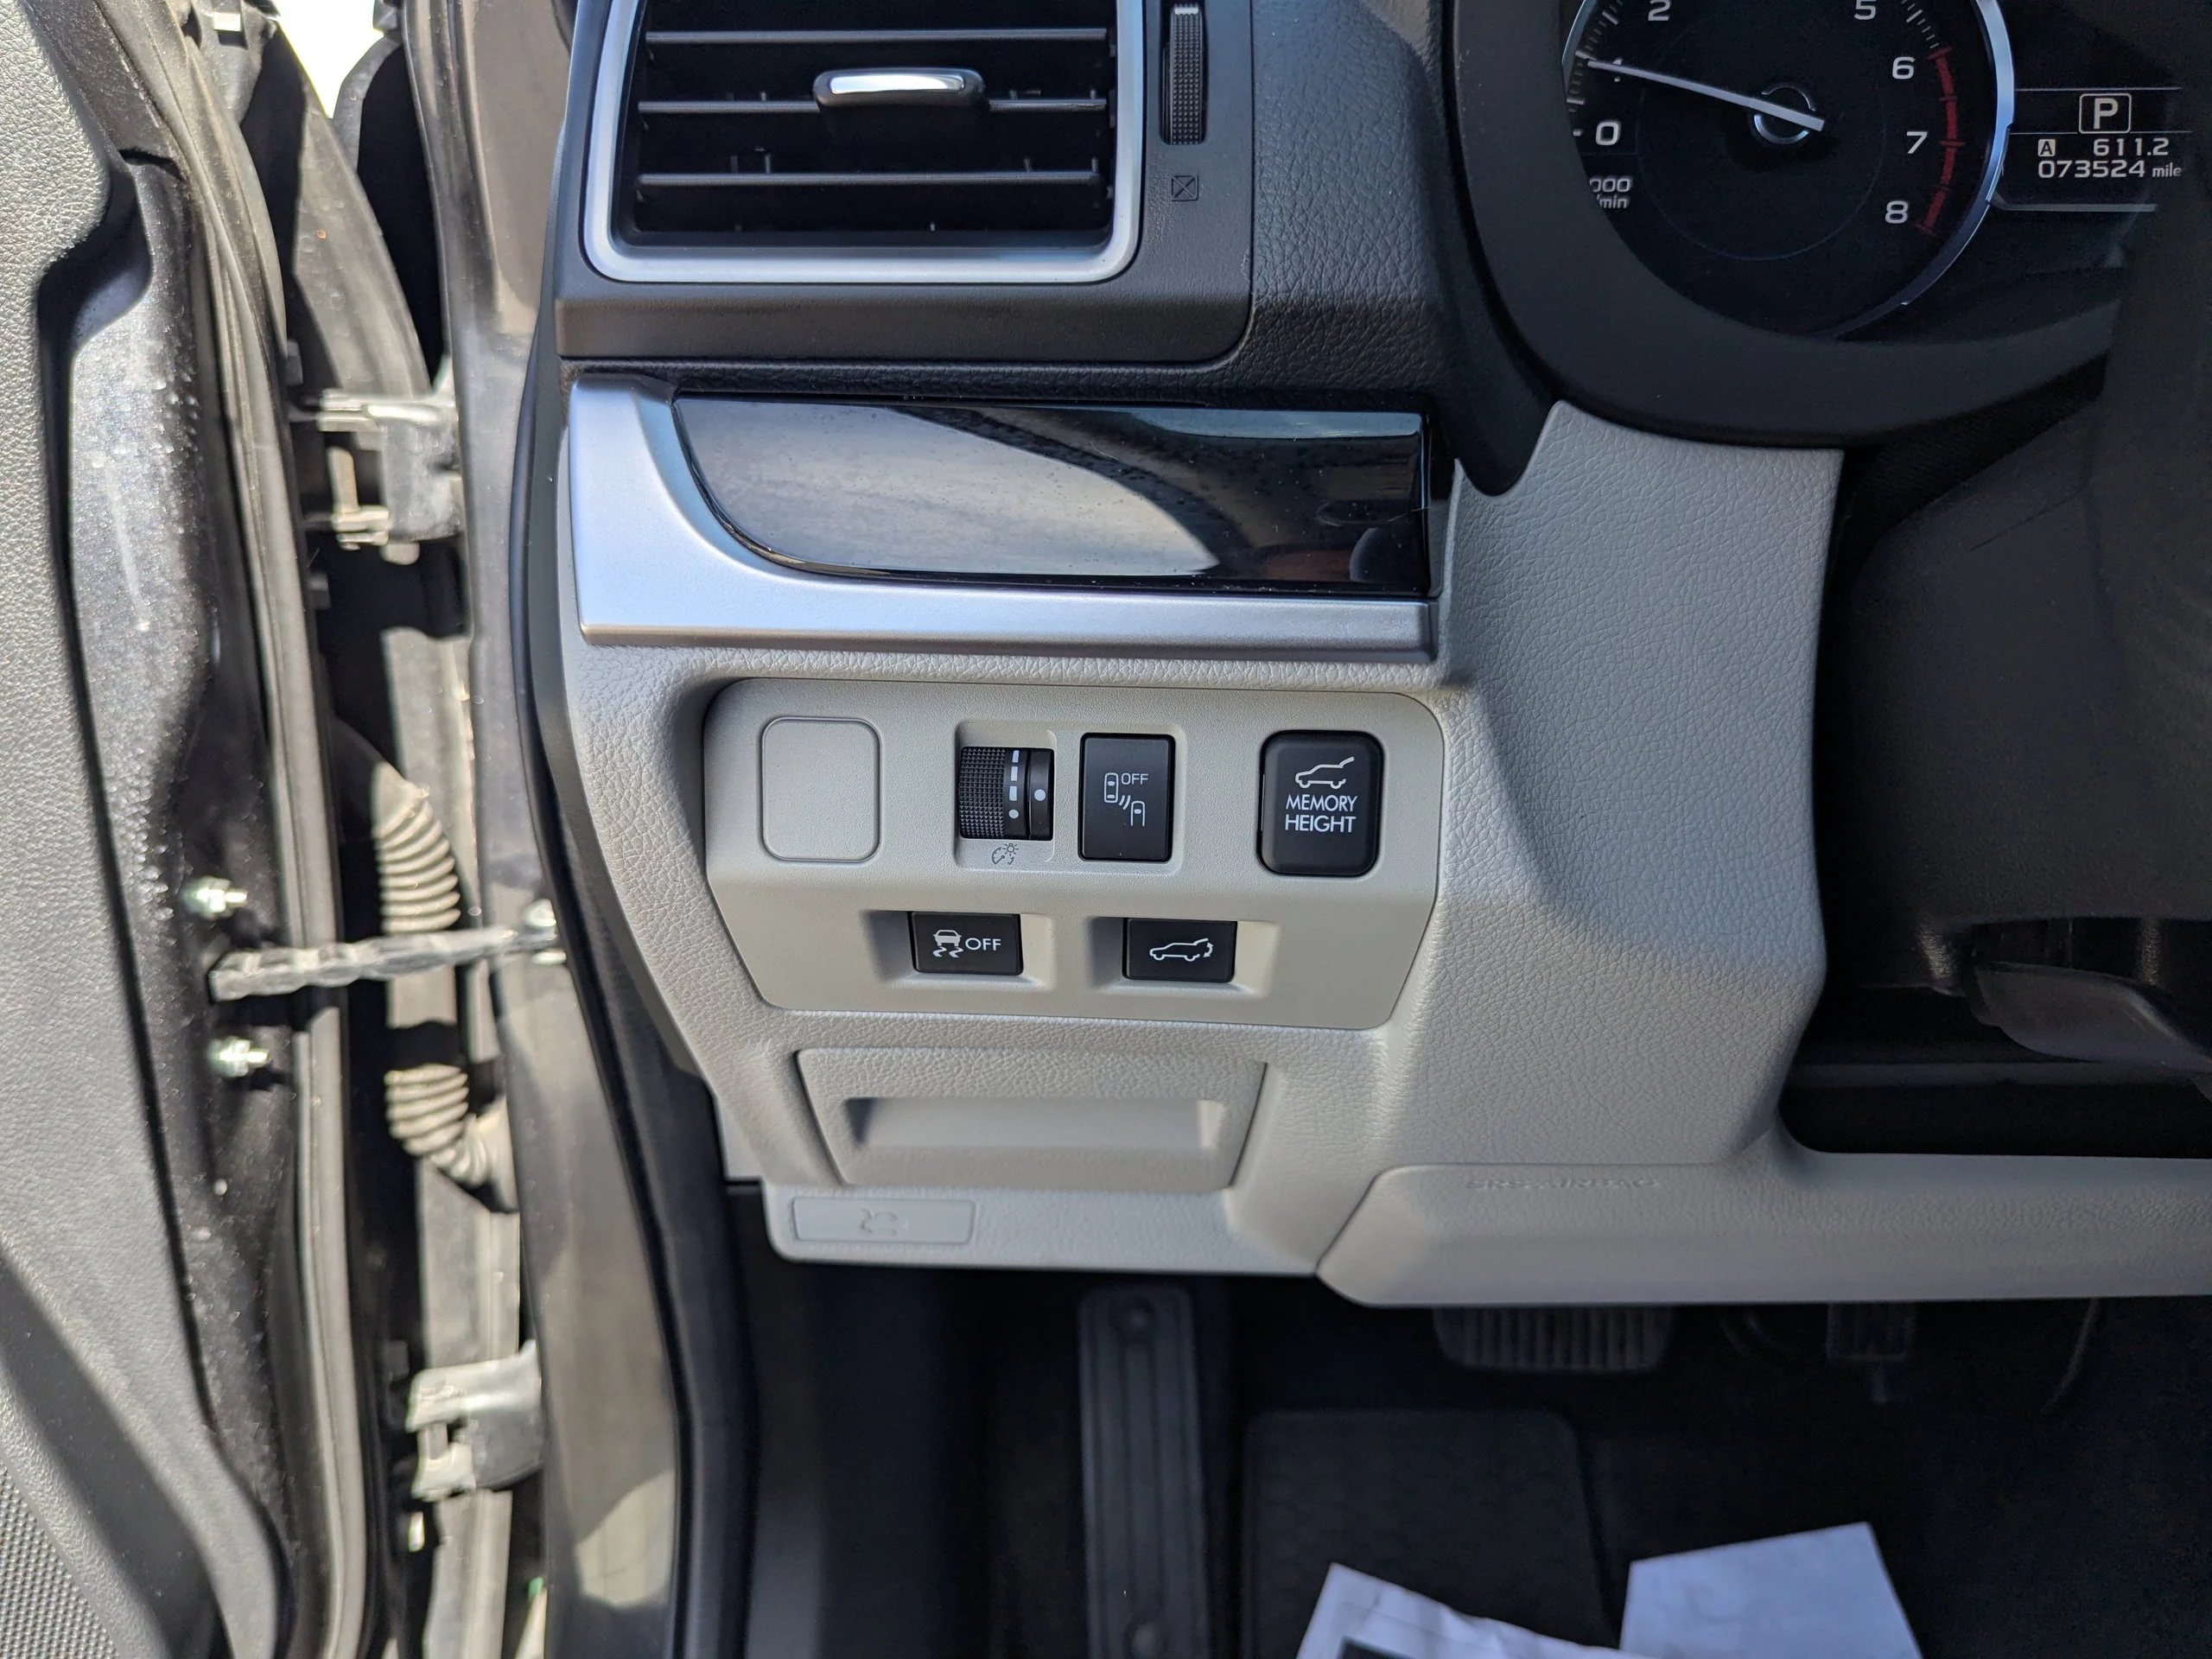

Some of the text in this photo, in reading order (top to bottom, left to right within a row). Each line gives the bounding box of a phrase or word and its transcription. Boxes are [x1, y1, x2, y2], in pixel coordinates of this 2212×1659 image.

[1648, 0, 1670, 22] 2
[1854, 0, 1877, 21] 5
[1891, 56, 1916, 79] 6
[2093, 97, 2120, 130] P
[1595, 121, 1621, 146] 0
[1905, 130, 1929, 155] 7
[2039, 137, 2170, 156] A 611.2
[2037, 159, 2183, 179] 073524 mile
[1884, 200, 1910, 225] 8
[1121, 772, 1149, 785] OFF
[1285, 793, 1358, 812] MEMORY
[1285, 813, 1357, 833] HEIGHT
[964, 937, 1002, 951] OFF
